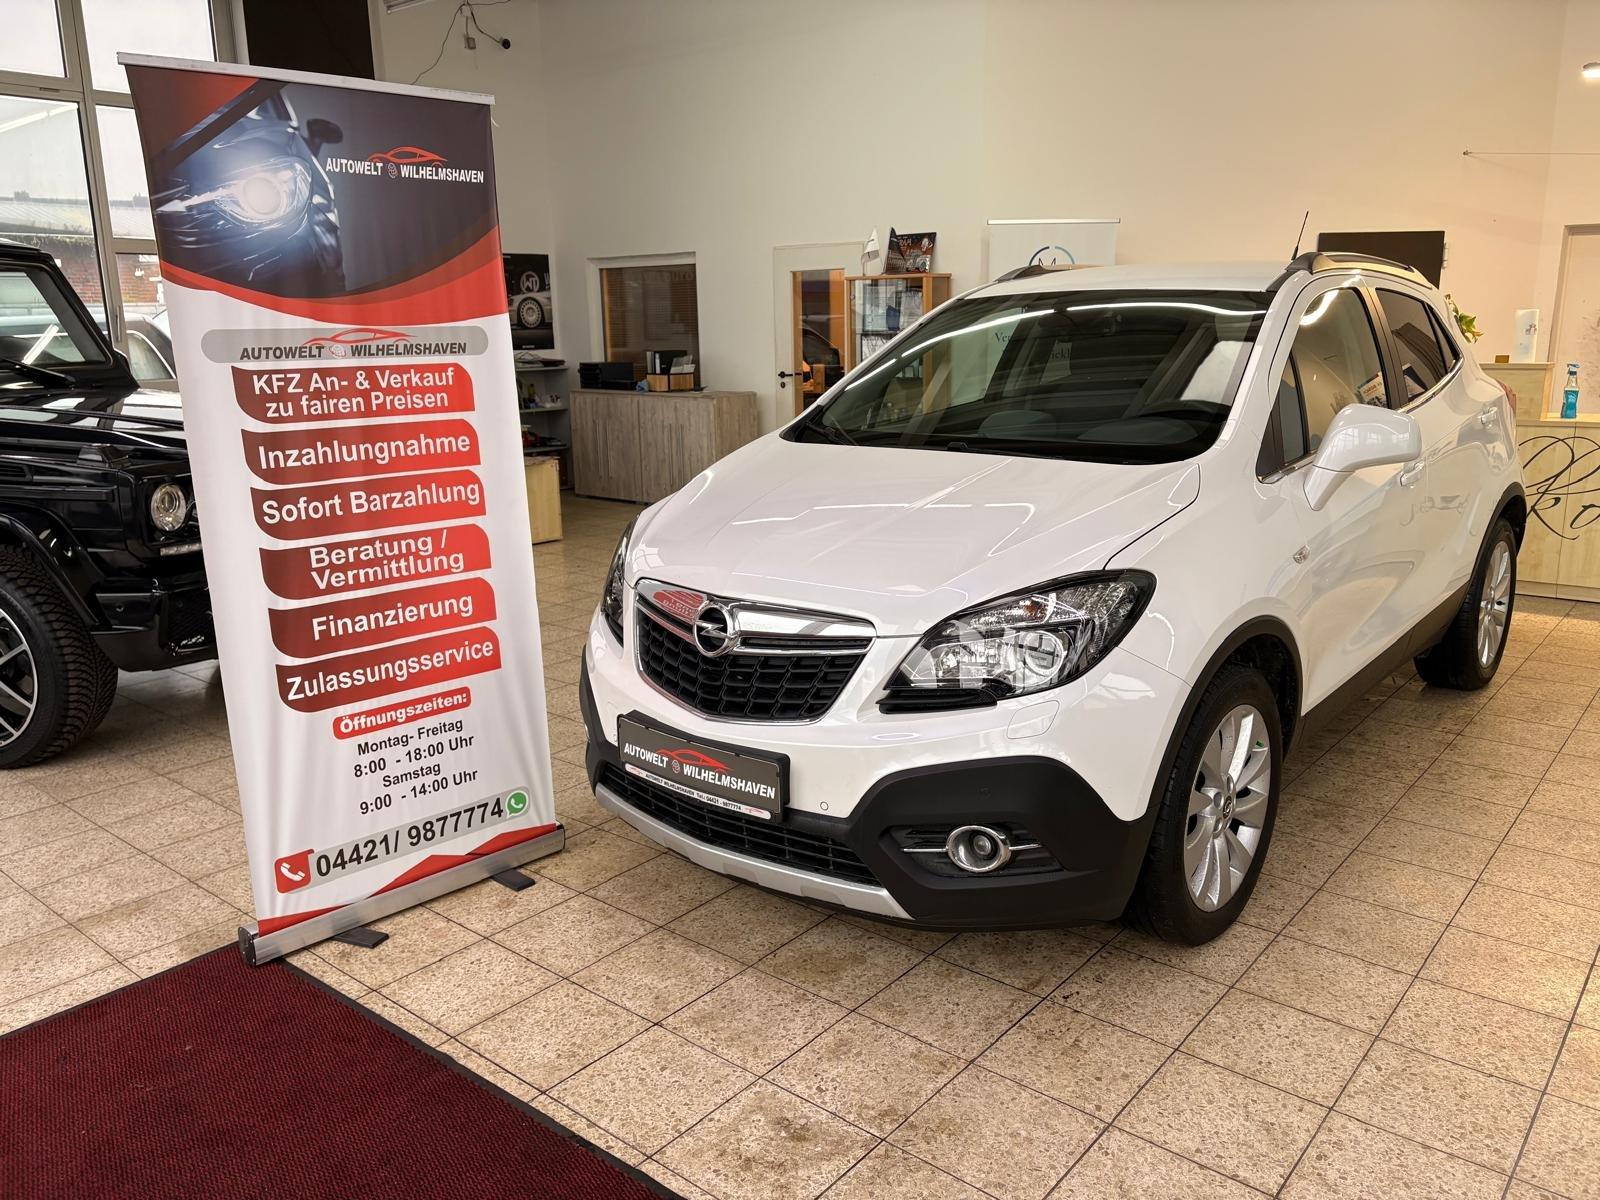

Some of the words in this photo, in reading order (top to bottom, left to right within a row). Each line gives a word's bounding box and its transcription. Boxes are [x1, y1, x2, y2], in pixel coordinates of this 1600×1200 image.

[326, 158, 383, 175] AUTOWELT
[400, 164, 484, 183] WILHELMSHAVEN
[240, 345, 325, 360] AUTOWELT
[350, 342, 467, 357] WILHELMSHAVEN
[252, 374, 303, 395] KFZ
[309, 372, 348, 392] An-
[355, 371, 370, 389] &
[375, 367, 454, 388] Verkauf
[265, 400, 294, 417] zu
[300, 395, 365, 416] fairen
[372, 390, 448, 411] Preisen
[258, 433, 470, 469] Inzahlungnahme
[263, 495, 343, 524] Sofort
[350, 483, 480, 514] Barzahlung
[309, 535, 433, 568] Beratung
[311, 552, 464, 590] Vermittlung
[312, 595, 473, 640] Finanzierung
[286, 640, 494, 700] Zulassungsservice
[340, 692, 467, 733] Öffnungszeiten:
[353, 758, 386, 777] 8:00
[405, 742, 444, 764] 18:00
[449, 734, 474, 751] Uhr
[357, 733, 414, 756] Montag-
[417, 719, 463, 740] Freitag
[382, 763, 441, 788] Samstag
[624, 743, 669, 768] AUTOWELT
[683, 764, 775, 799] WILHELMSHAVEN
[664, 780, 695, 796] WILHELMSHAVEN
[360, 794, 392, 814] 9:00
[410, 777, 448, 798] 14:00
[453, 769, 478, 786] Uhr
[316, 830, 400, 877] 04421/
[407, 798, 503, 847] 9877774
